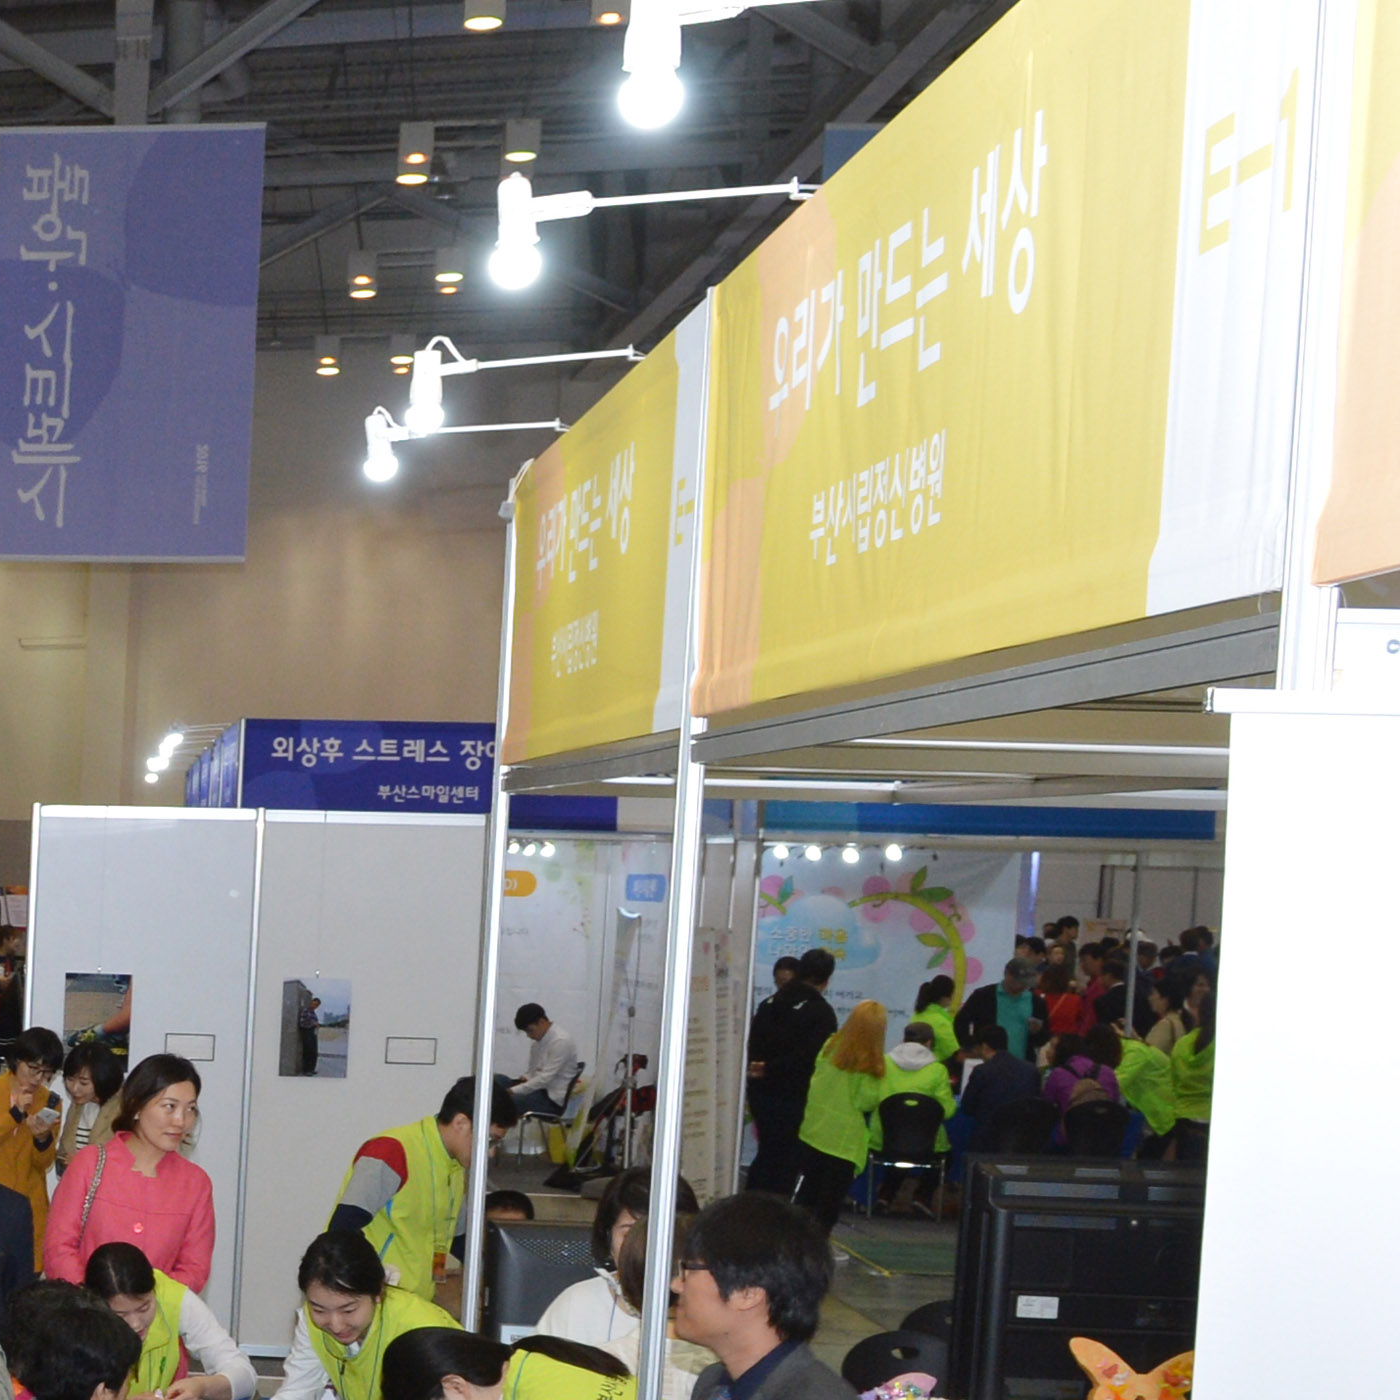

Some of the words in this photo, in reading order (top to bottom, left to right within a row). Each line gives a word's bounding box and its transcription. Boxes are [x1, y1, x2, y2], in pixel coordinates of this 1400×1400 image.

[1200, 67, 1298, 256] E-1
[769, 269, 845, 438] 우리가
[857, 206, 948, 409] 만드는
[961, 108, 1048, 314] 세상
[808, 428, 946, 566] 부산시립정신병원
[271, 736, 344, 767] 외상후
[352, 738, 451, 763] 스트레스
[377, 784, 480, 804] 부산스마일센터
